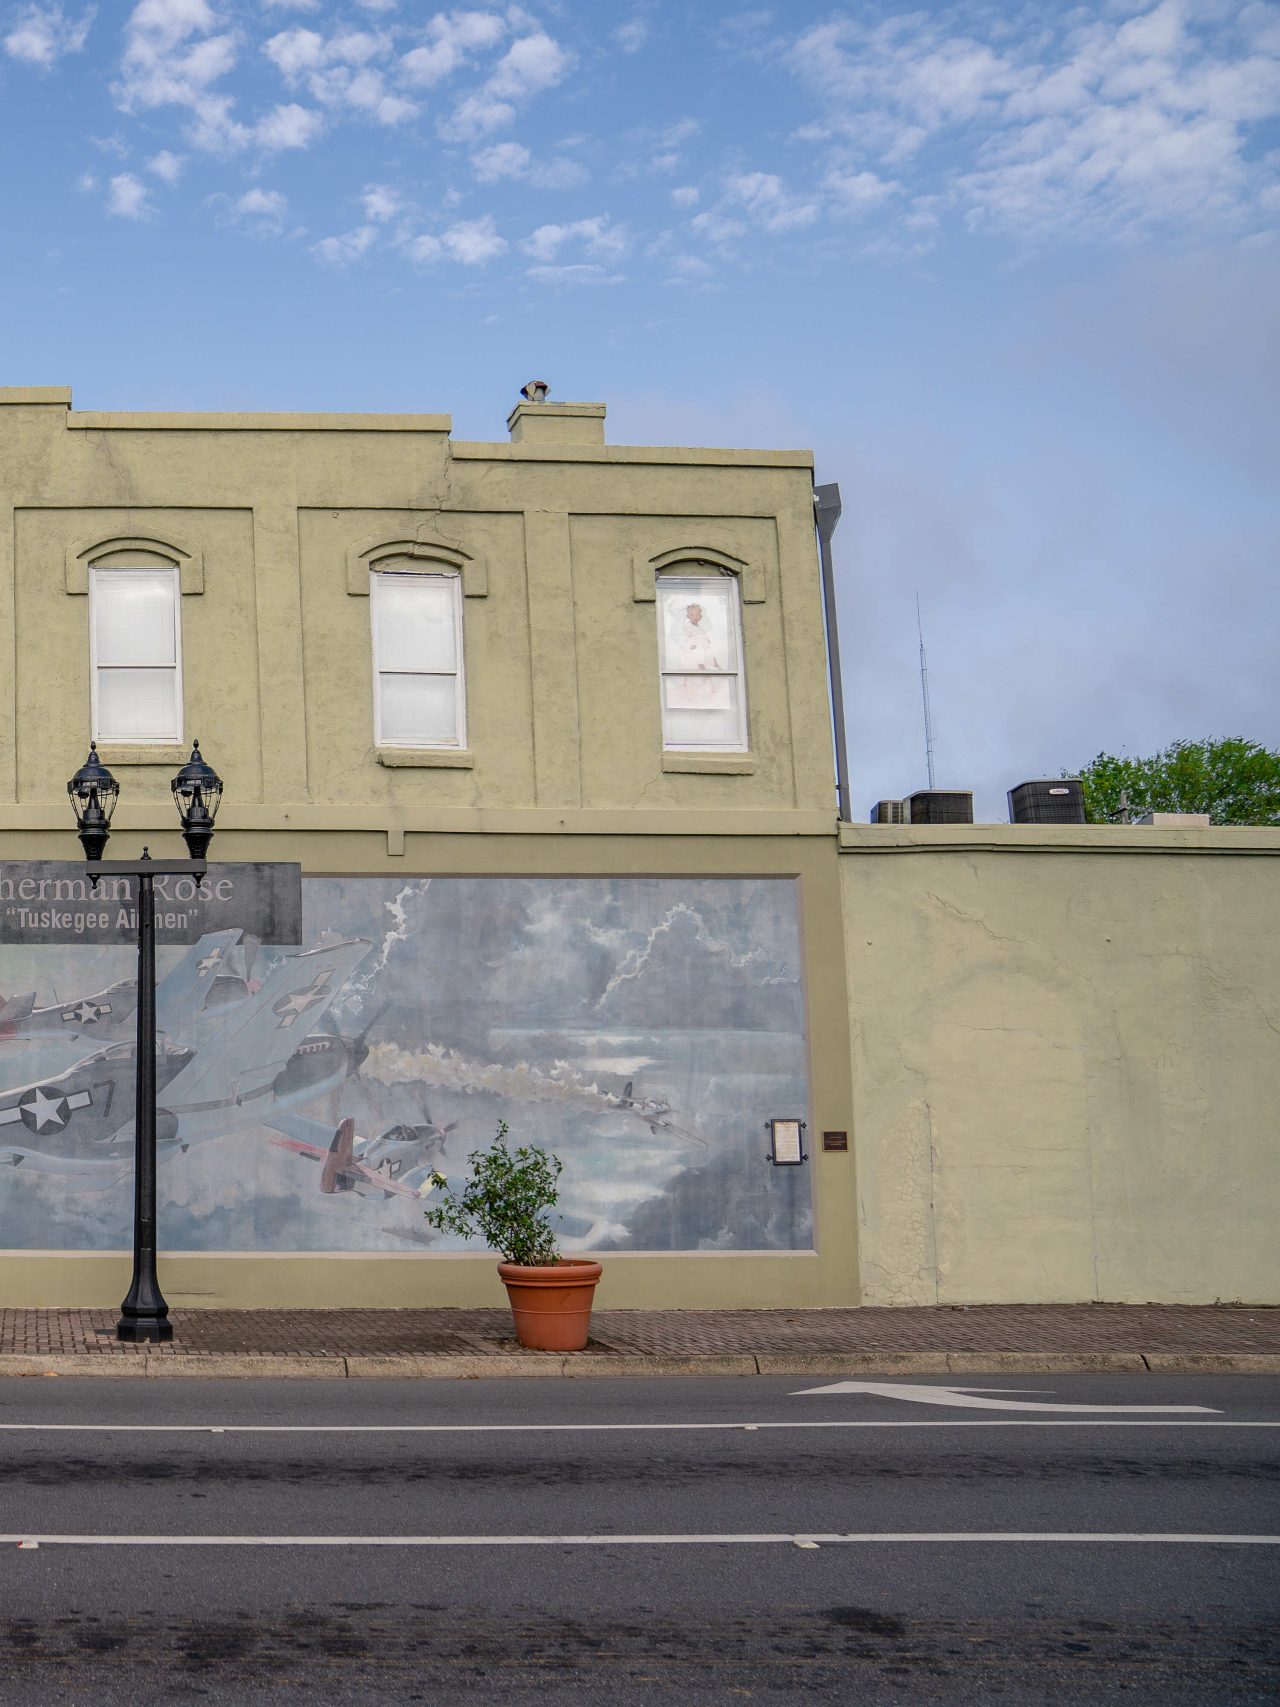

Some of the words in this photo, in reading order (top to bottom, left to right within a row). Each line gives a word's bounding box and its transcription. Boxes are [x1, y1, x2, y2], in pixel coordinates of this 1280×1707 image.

[152, 874, 233, 901] Rose
[6, 908, 109, 934] “Tuskegee
[115, 908, 198, 929] Aien”
[93, 1080, 115, 1118] 7
